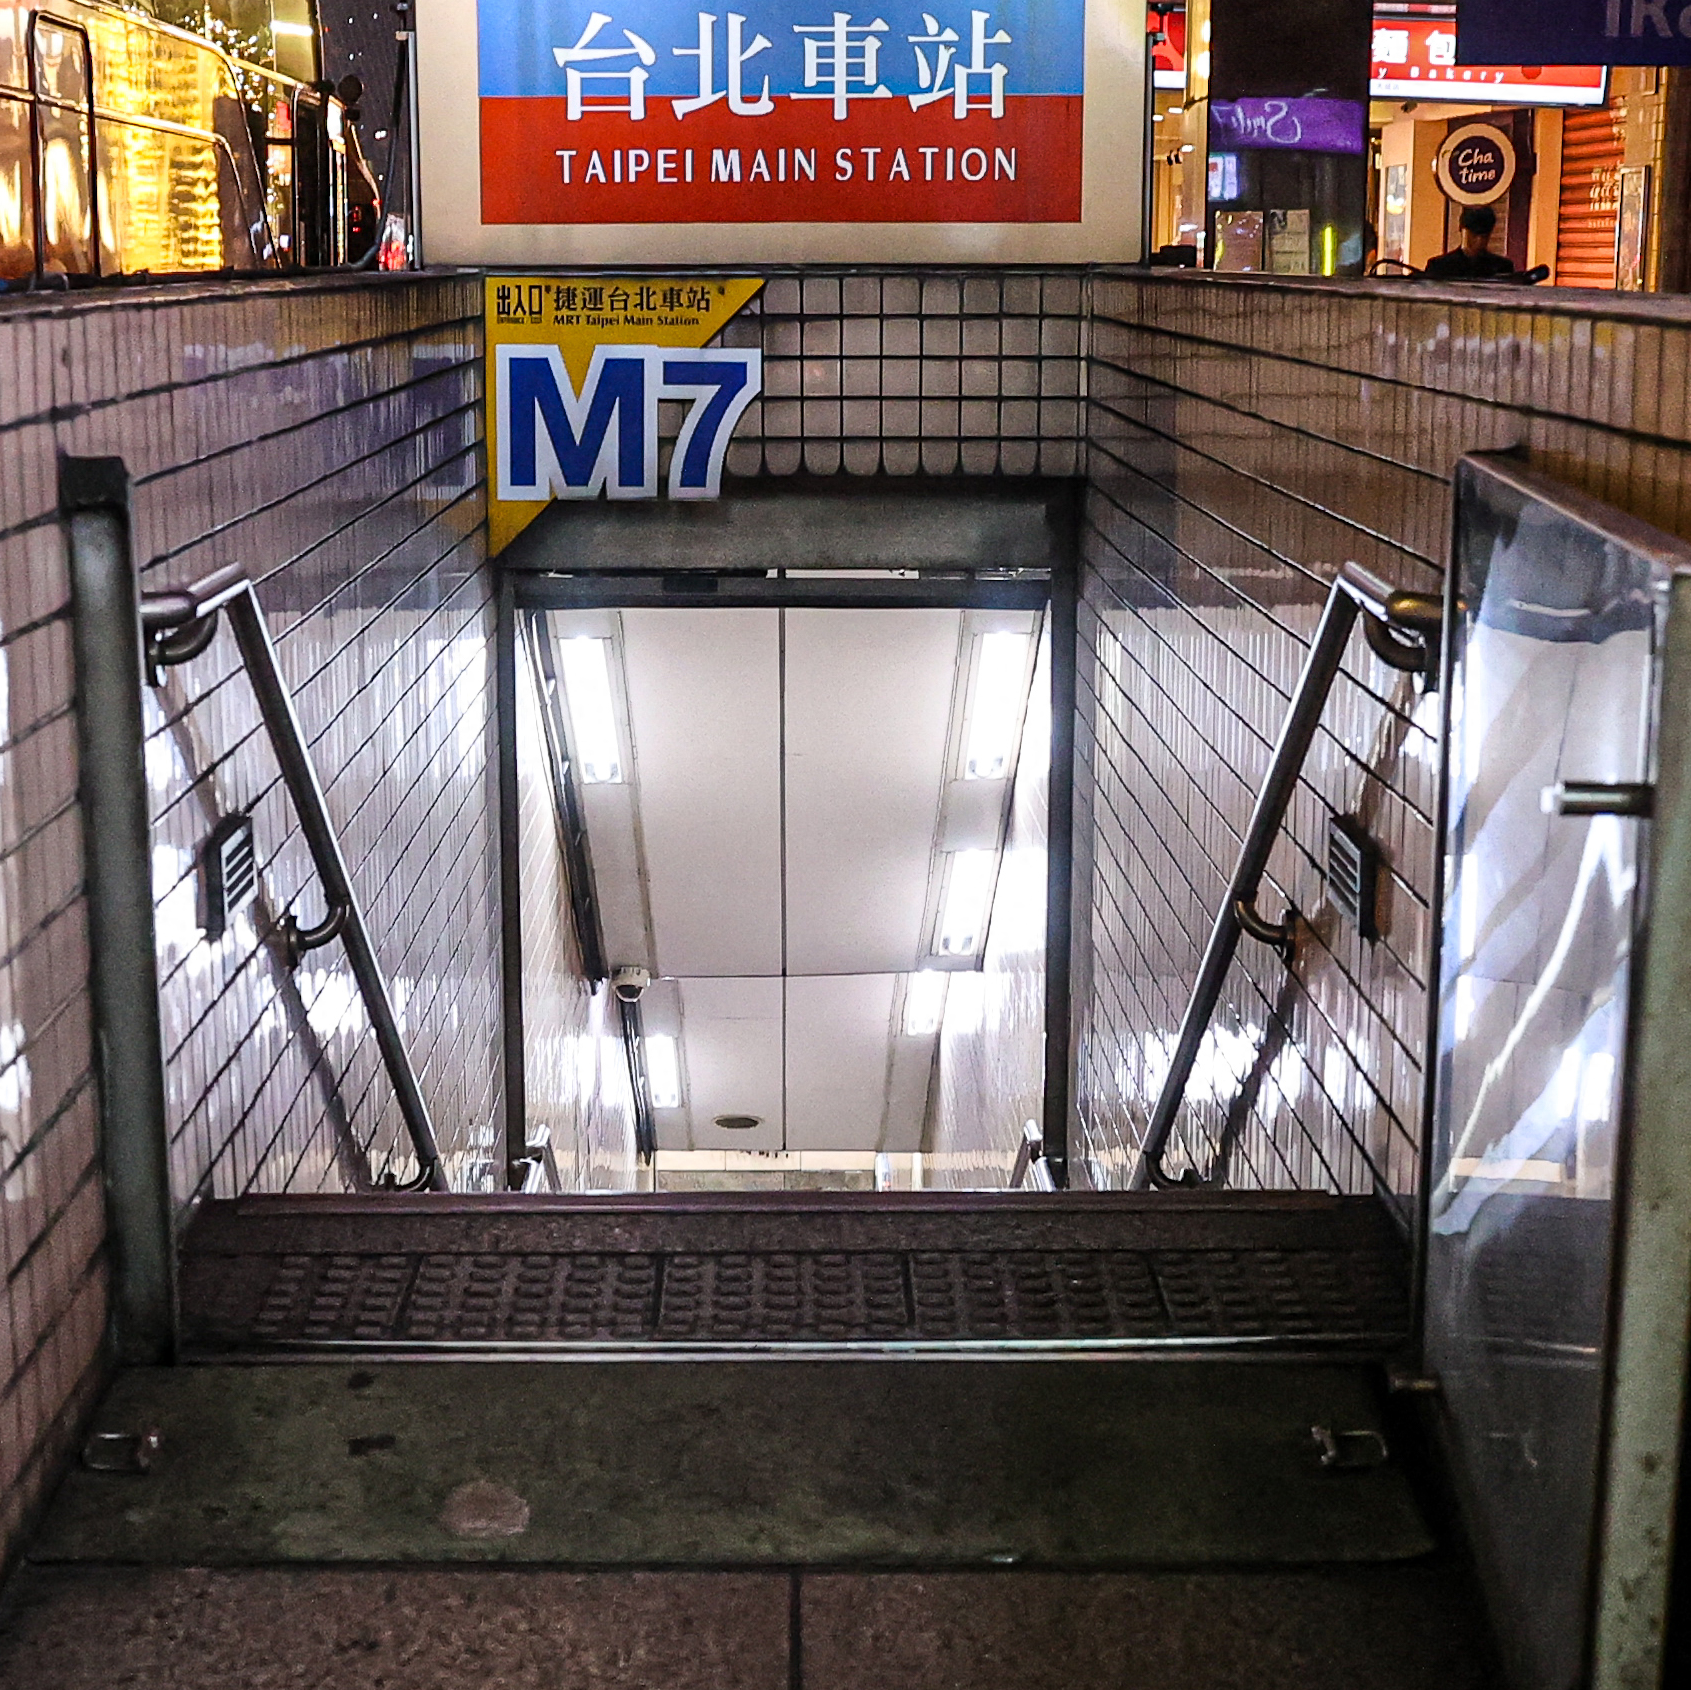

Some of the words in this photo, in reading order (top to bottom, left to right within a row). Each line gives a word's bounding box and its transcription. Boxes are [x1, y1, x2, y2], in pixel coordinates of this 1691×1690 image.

[553, 9, 1013, 122] 台北車站
[1410, 66, 1504, 83] Bakery
[556, 149, 694, 184] TAIPEI
[710, 148, 816, 183] MAIN
[835, 147, 1018, 182] STATION
[1458, 148, 1494, 167] Cha
[1459, 167, 1496, 184] time
[497, 285, 543, 316] 出入口
[553, 286, 711, 313] 捷運台北車站
[553, 315, 580, 326] MRT
[585, 315, 620, 329] Taipei
[623, 315, 653, 326] Main
[656, 315, 700, 326] Station
[501, 350, 756, 494] M7
